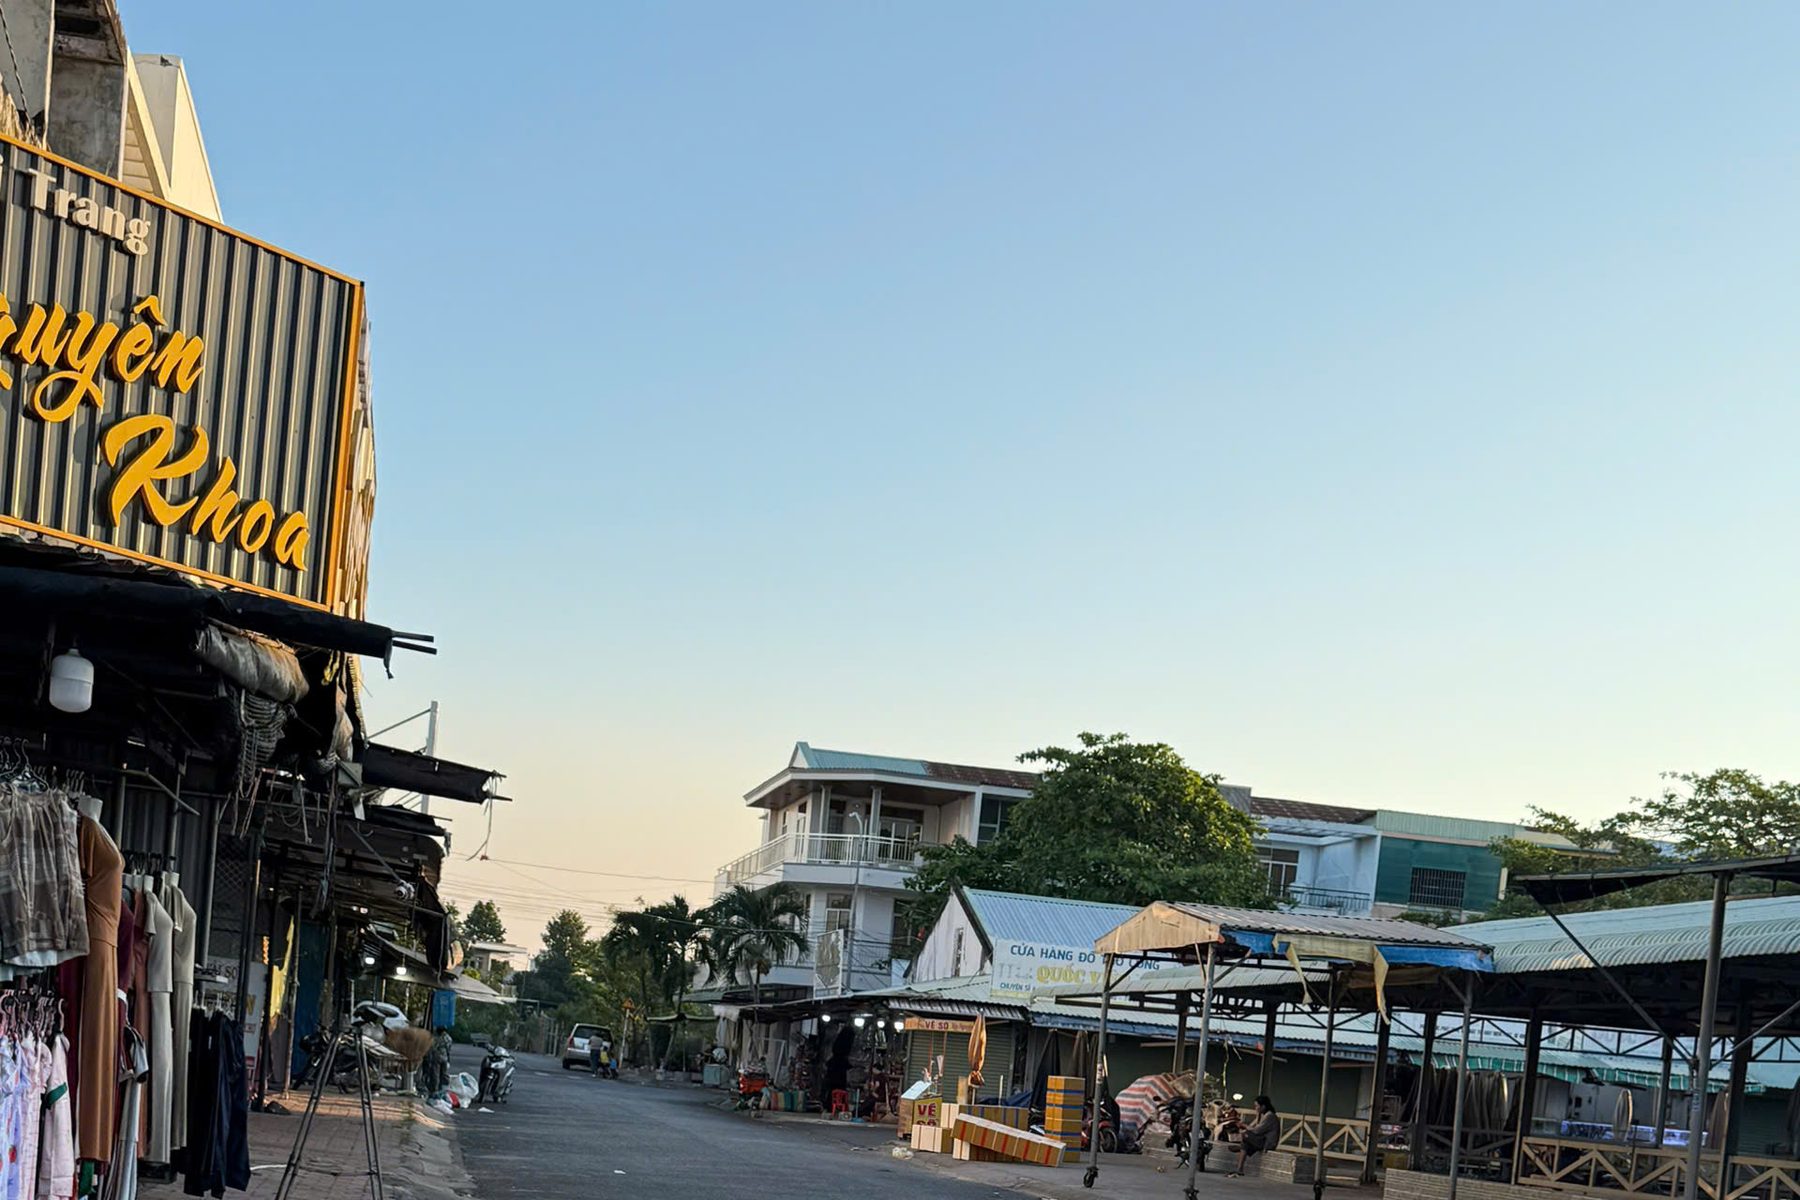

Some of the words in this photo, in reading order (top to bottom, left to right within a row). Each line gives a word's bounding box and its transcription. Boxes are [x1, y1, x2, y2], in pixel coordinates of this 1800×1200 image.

[28, 168, 151, 256] Trang
[102, 413, 310, 572] Khoa
[1010, 943, 1035, 957] CỬA
[1040, 946, 1073, 961] HÀNG
